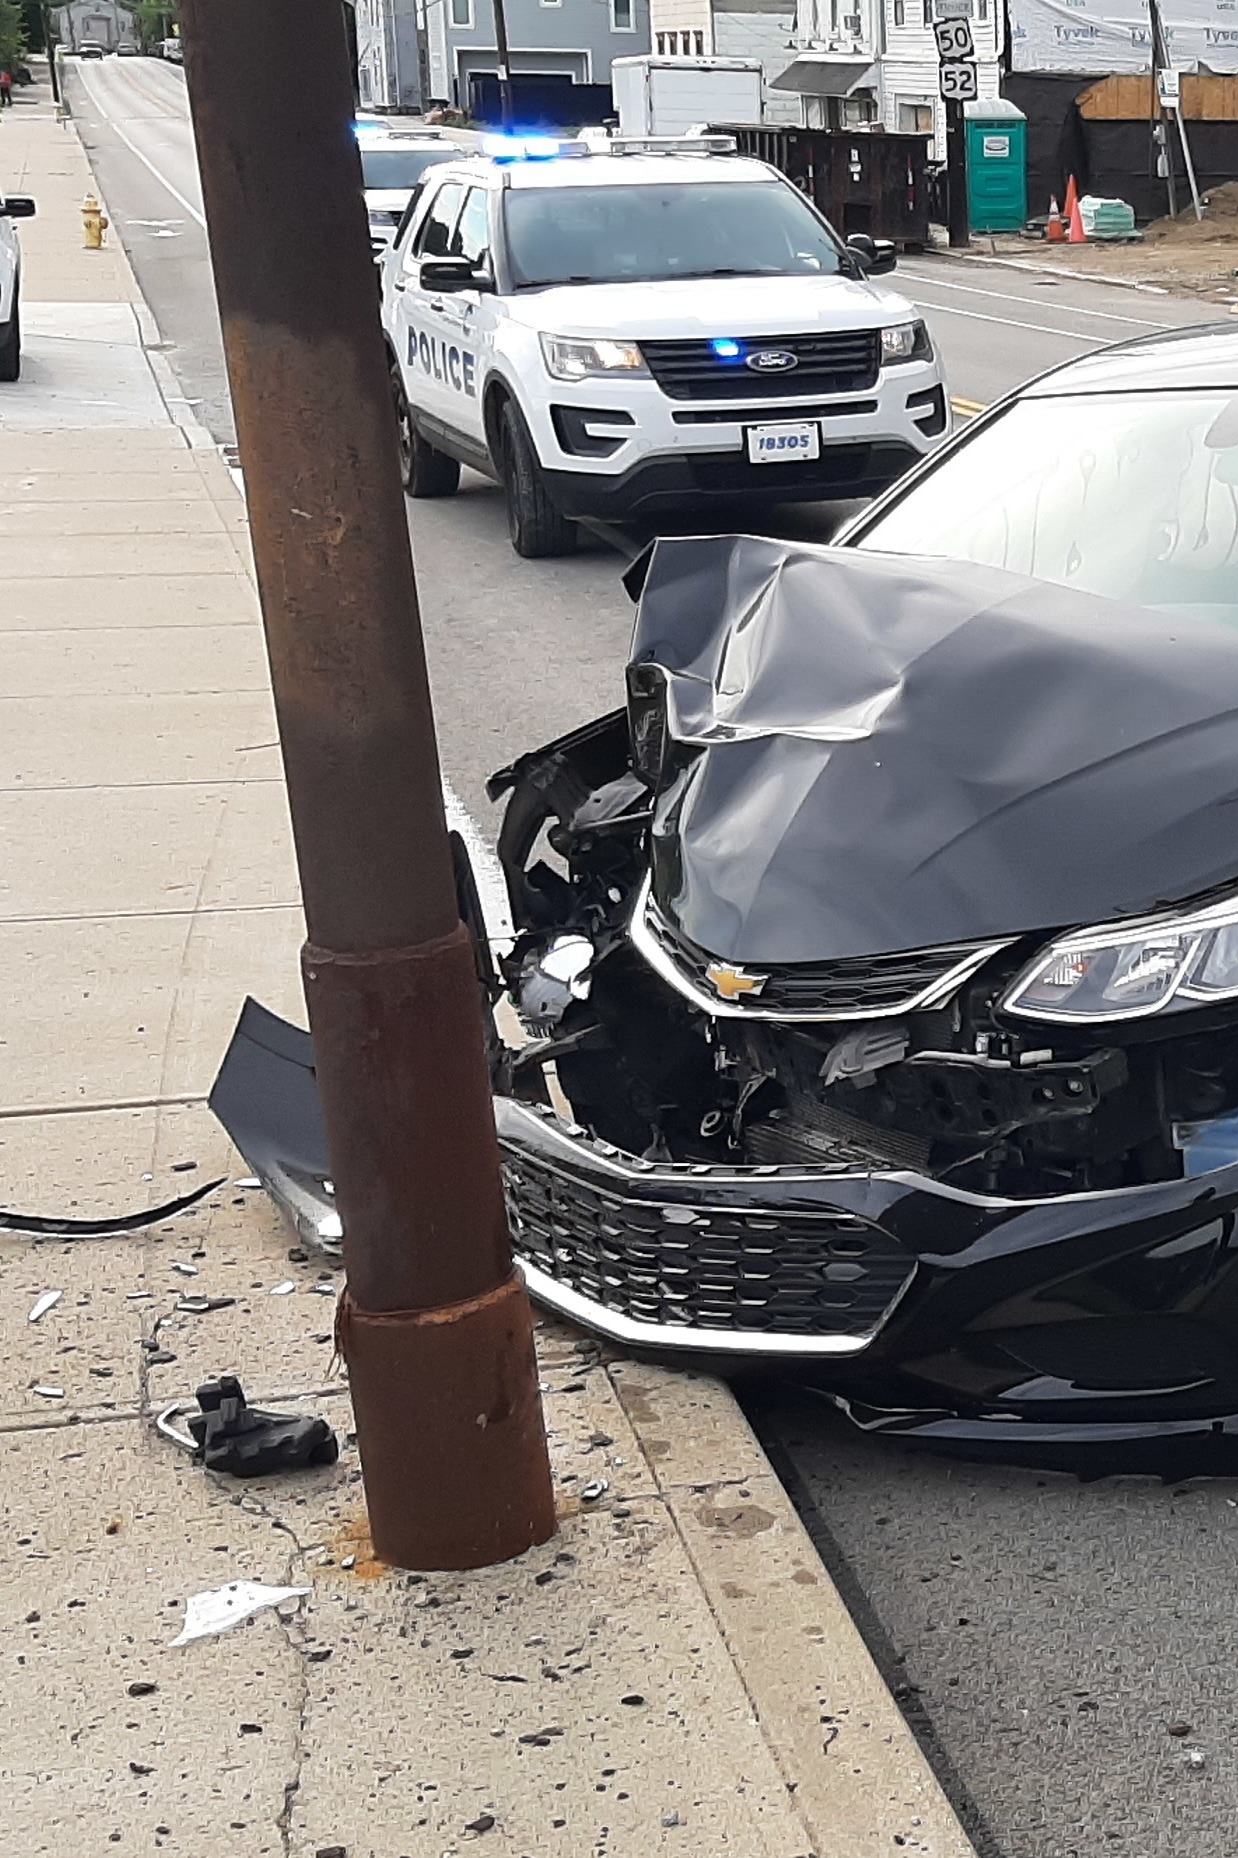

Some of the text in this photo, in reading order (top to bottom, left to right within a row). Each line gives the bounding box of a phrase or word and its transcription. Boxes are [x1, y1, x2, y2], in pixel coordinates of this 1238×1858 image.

[940, 27, 967, 51] 50
[944, 70, 973, 92] 52
[408, 325, 476, 398] POLICE
[759, 434, 810, 451] 18305
